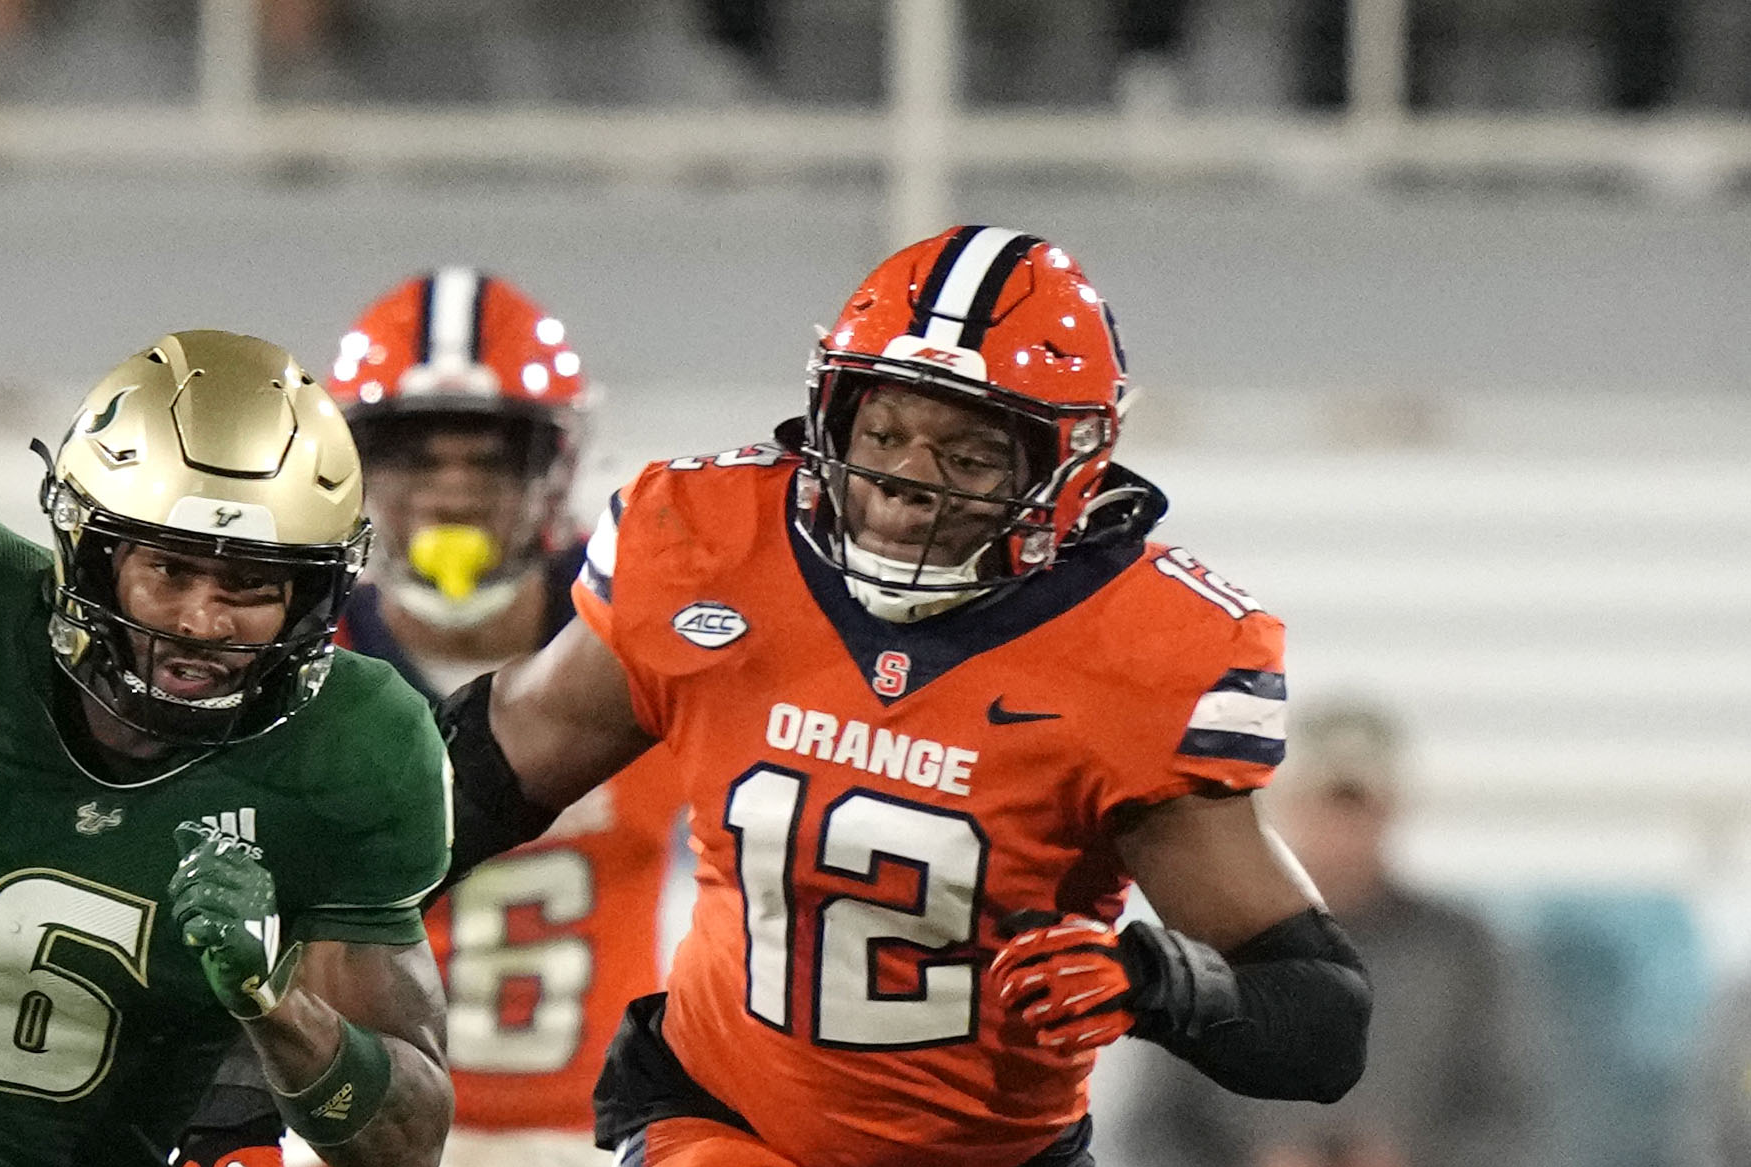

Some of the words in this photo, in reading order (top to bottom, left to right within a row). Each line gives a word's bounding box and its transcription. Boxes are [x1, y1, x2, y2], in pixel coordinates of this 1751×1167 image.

[682, 612, 739, 634] ACC
[872, 651, 911, 697] S
[766, 702, 979, 796] ORANGE
[723, 761, 991, 1052] 12
[448, 848, 594, 1077] 6
